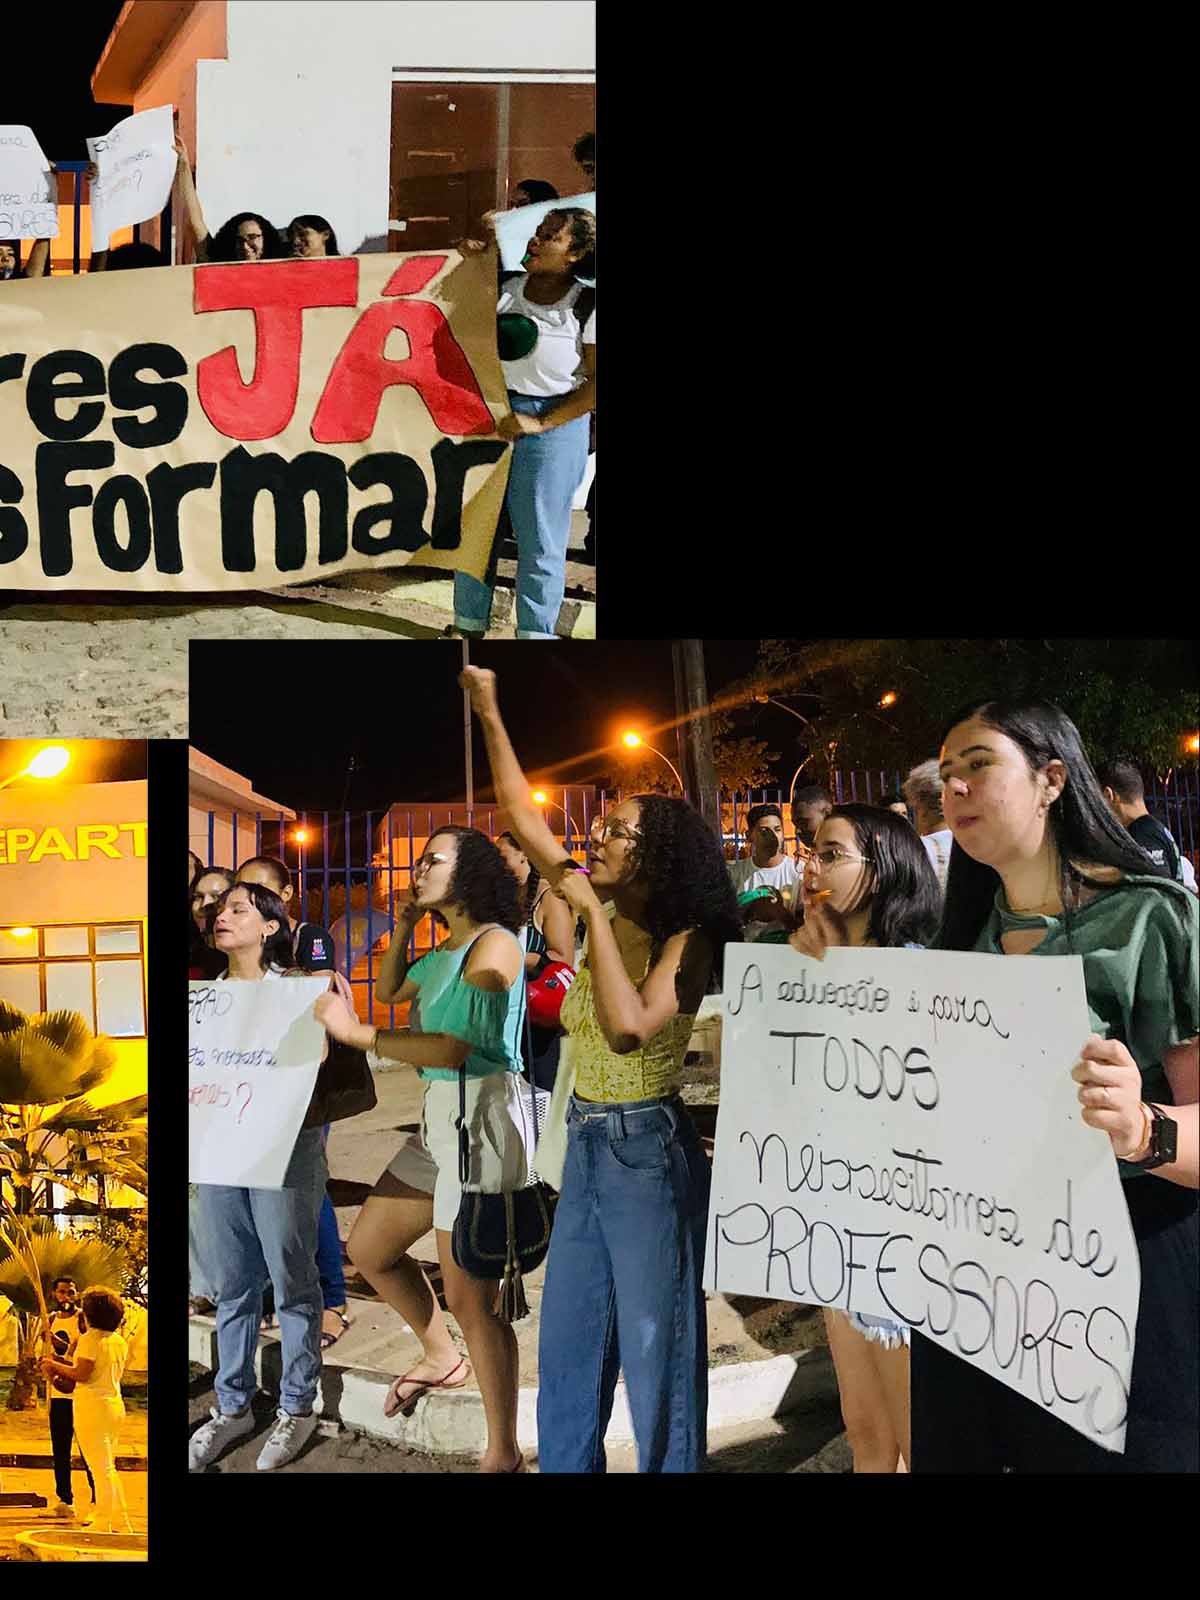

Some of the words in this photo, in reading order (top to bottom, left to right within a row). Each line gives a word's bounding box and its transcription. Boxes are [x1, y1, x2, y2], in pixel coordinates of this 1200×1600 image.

[192, 254, 497, 444] JÁ
[35, 437, 511, 577] Formar
[728, 963, 764, 1016] A
[769, 1029, 941, 1112] TODOS
[1043, 1178, 1118, 1279] de
[714, 1202, 1132, 1435] PROFESSORES
